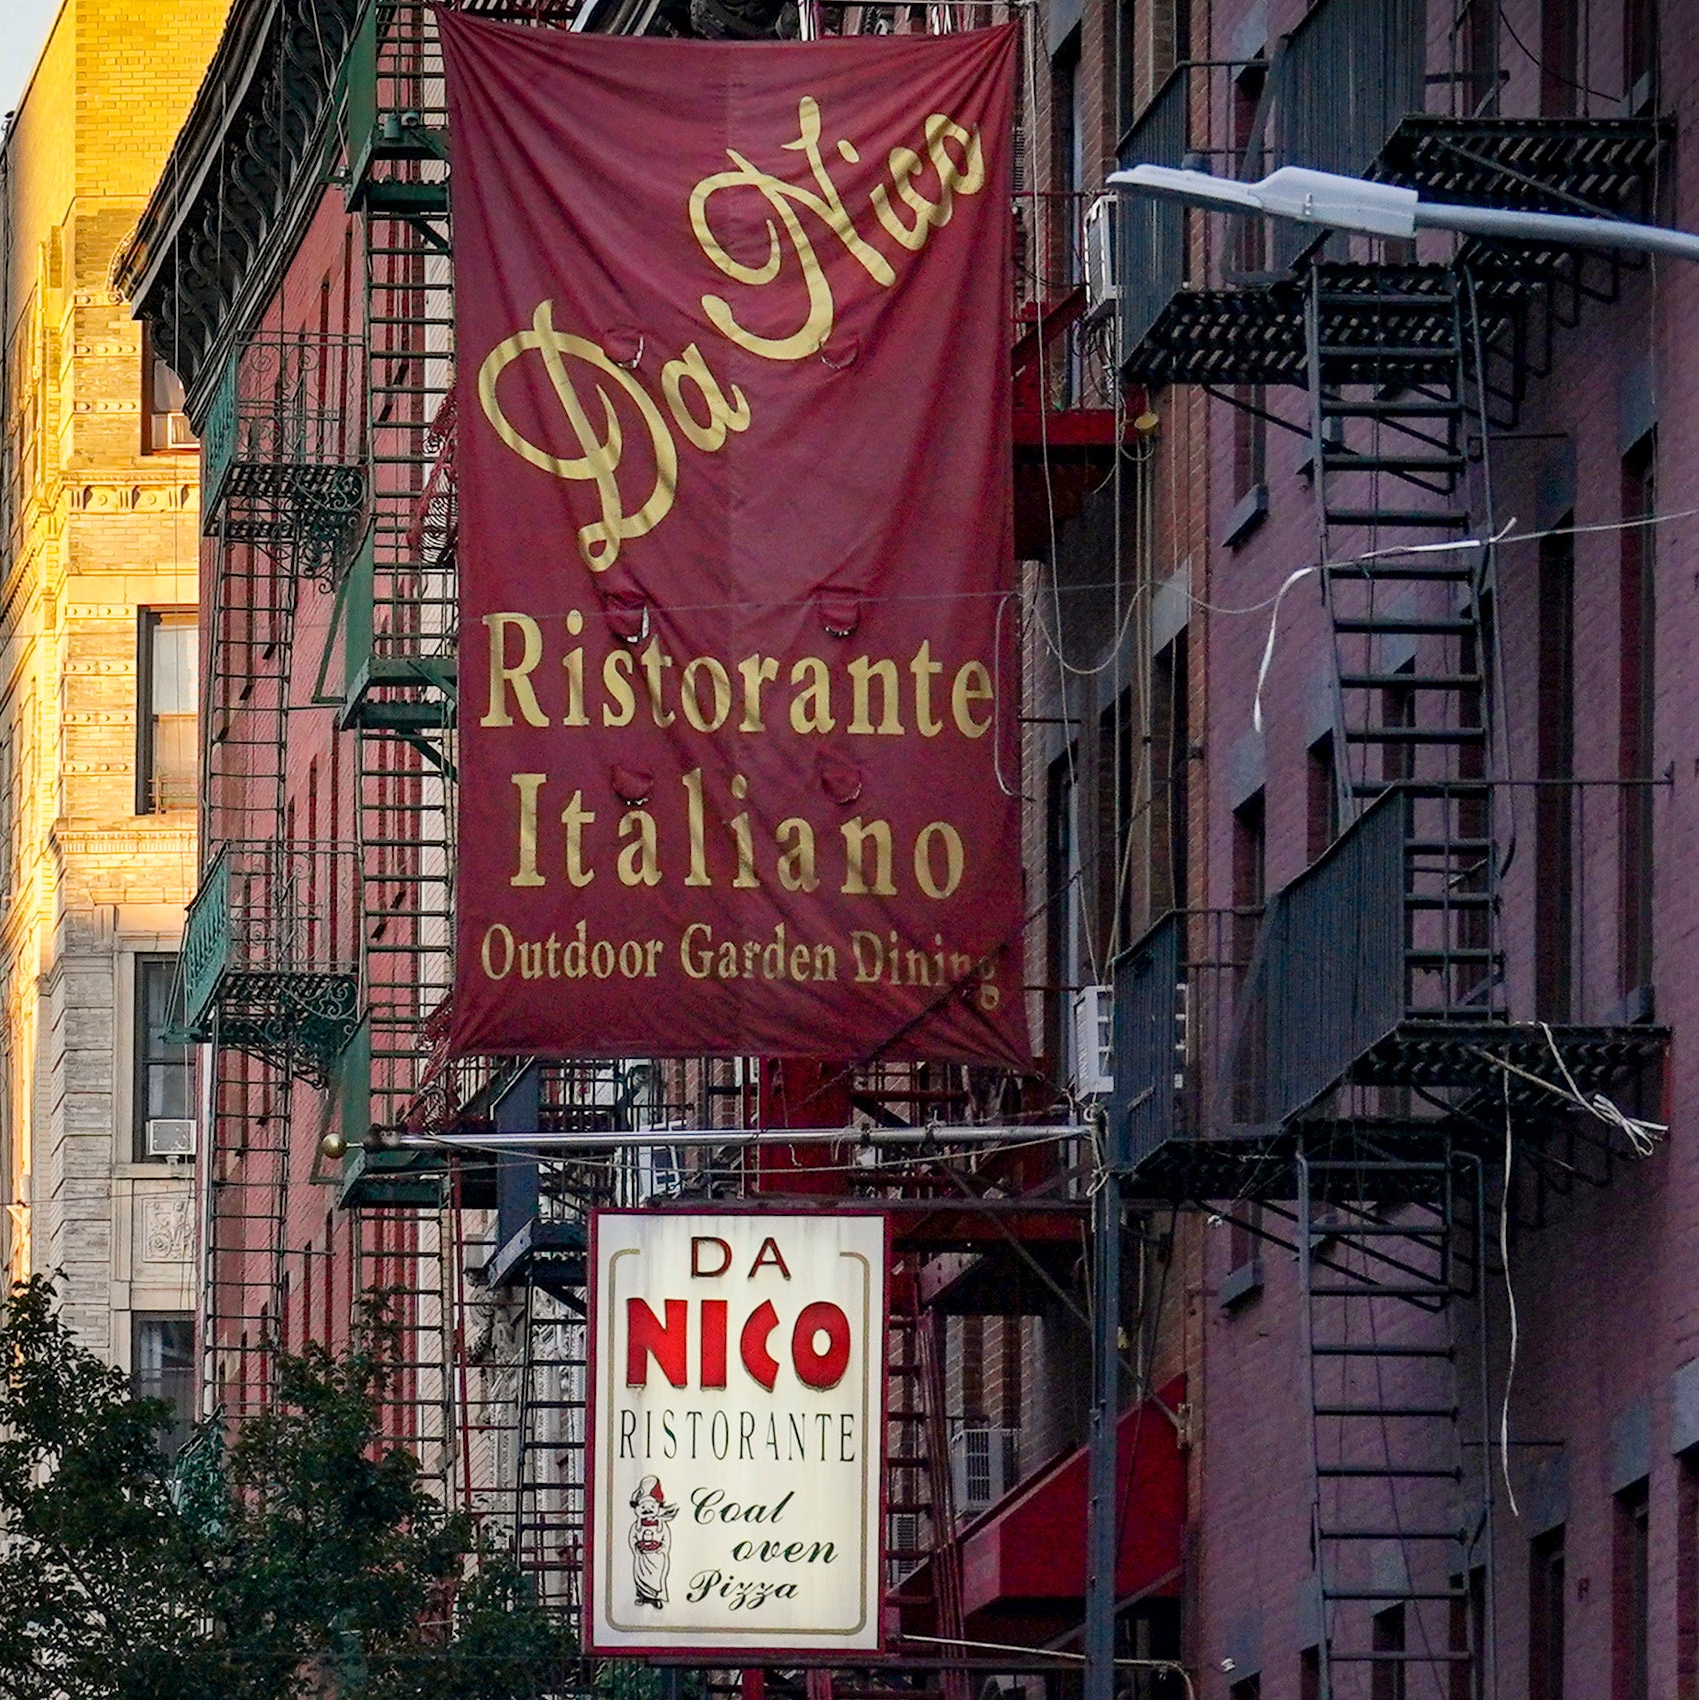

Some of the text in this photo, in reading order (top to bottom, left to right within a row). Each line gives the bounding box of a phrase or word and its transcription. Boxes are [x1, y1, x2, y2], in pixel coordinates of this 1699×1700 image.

[478, 95, 988, 572] Da Nico
[479, 609, 994, 738] Ristorante
[509, 768, 965, 899] Italiano
[480, 920, 999, 1009] Outdoor Garden Dining
[691, 1236, 791, 1281] DA
[626, 1296, 851, 1393] NICO
[619, 1409, 857, 1463] RISTORANTE
[690, 1486, 796, 1526] Coal
[732, 1539, 838, 1564] oven
[686, 1569, 799, 1611] Pizza
